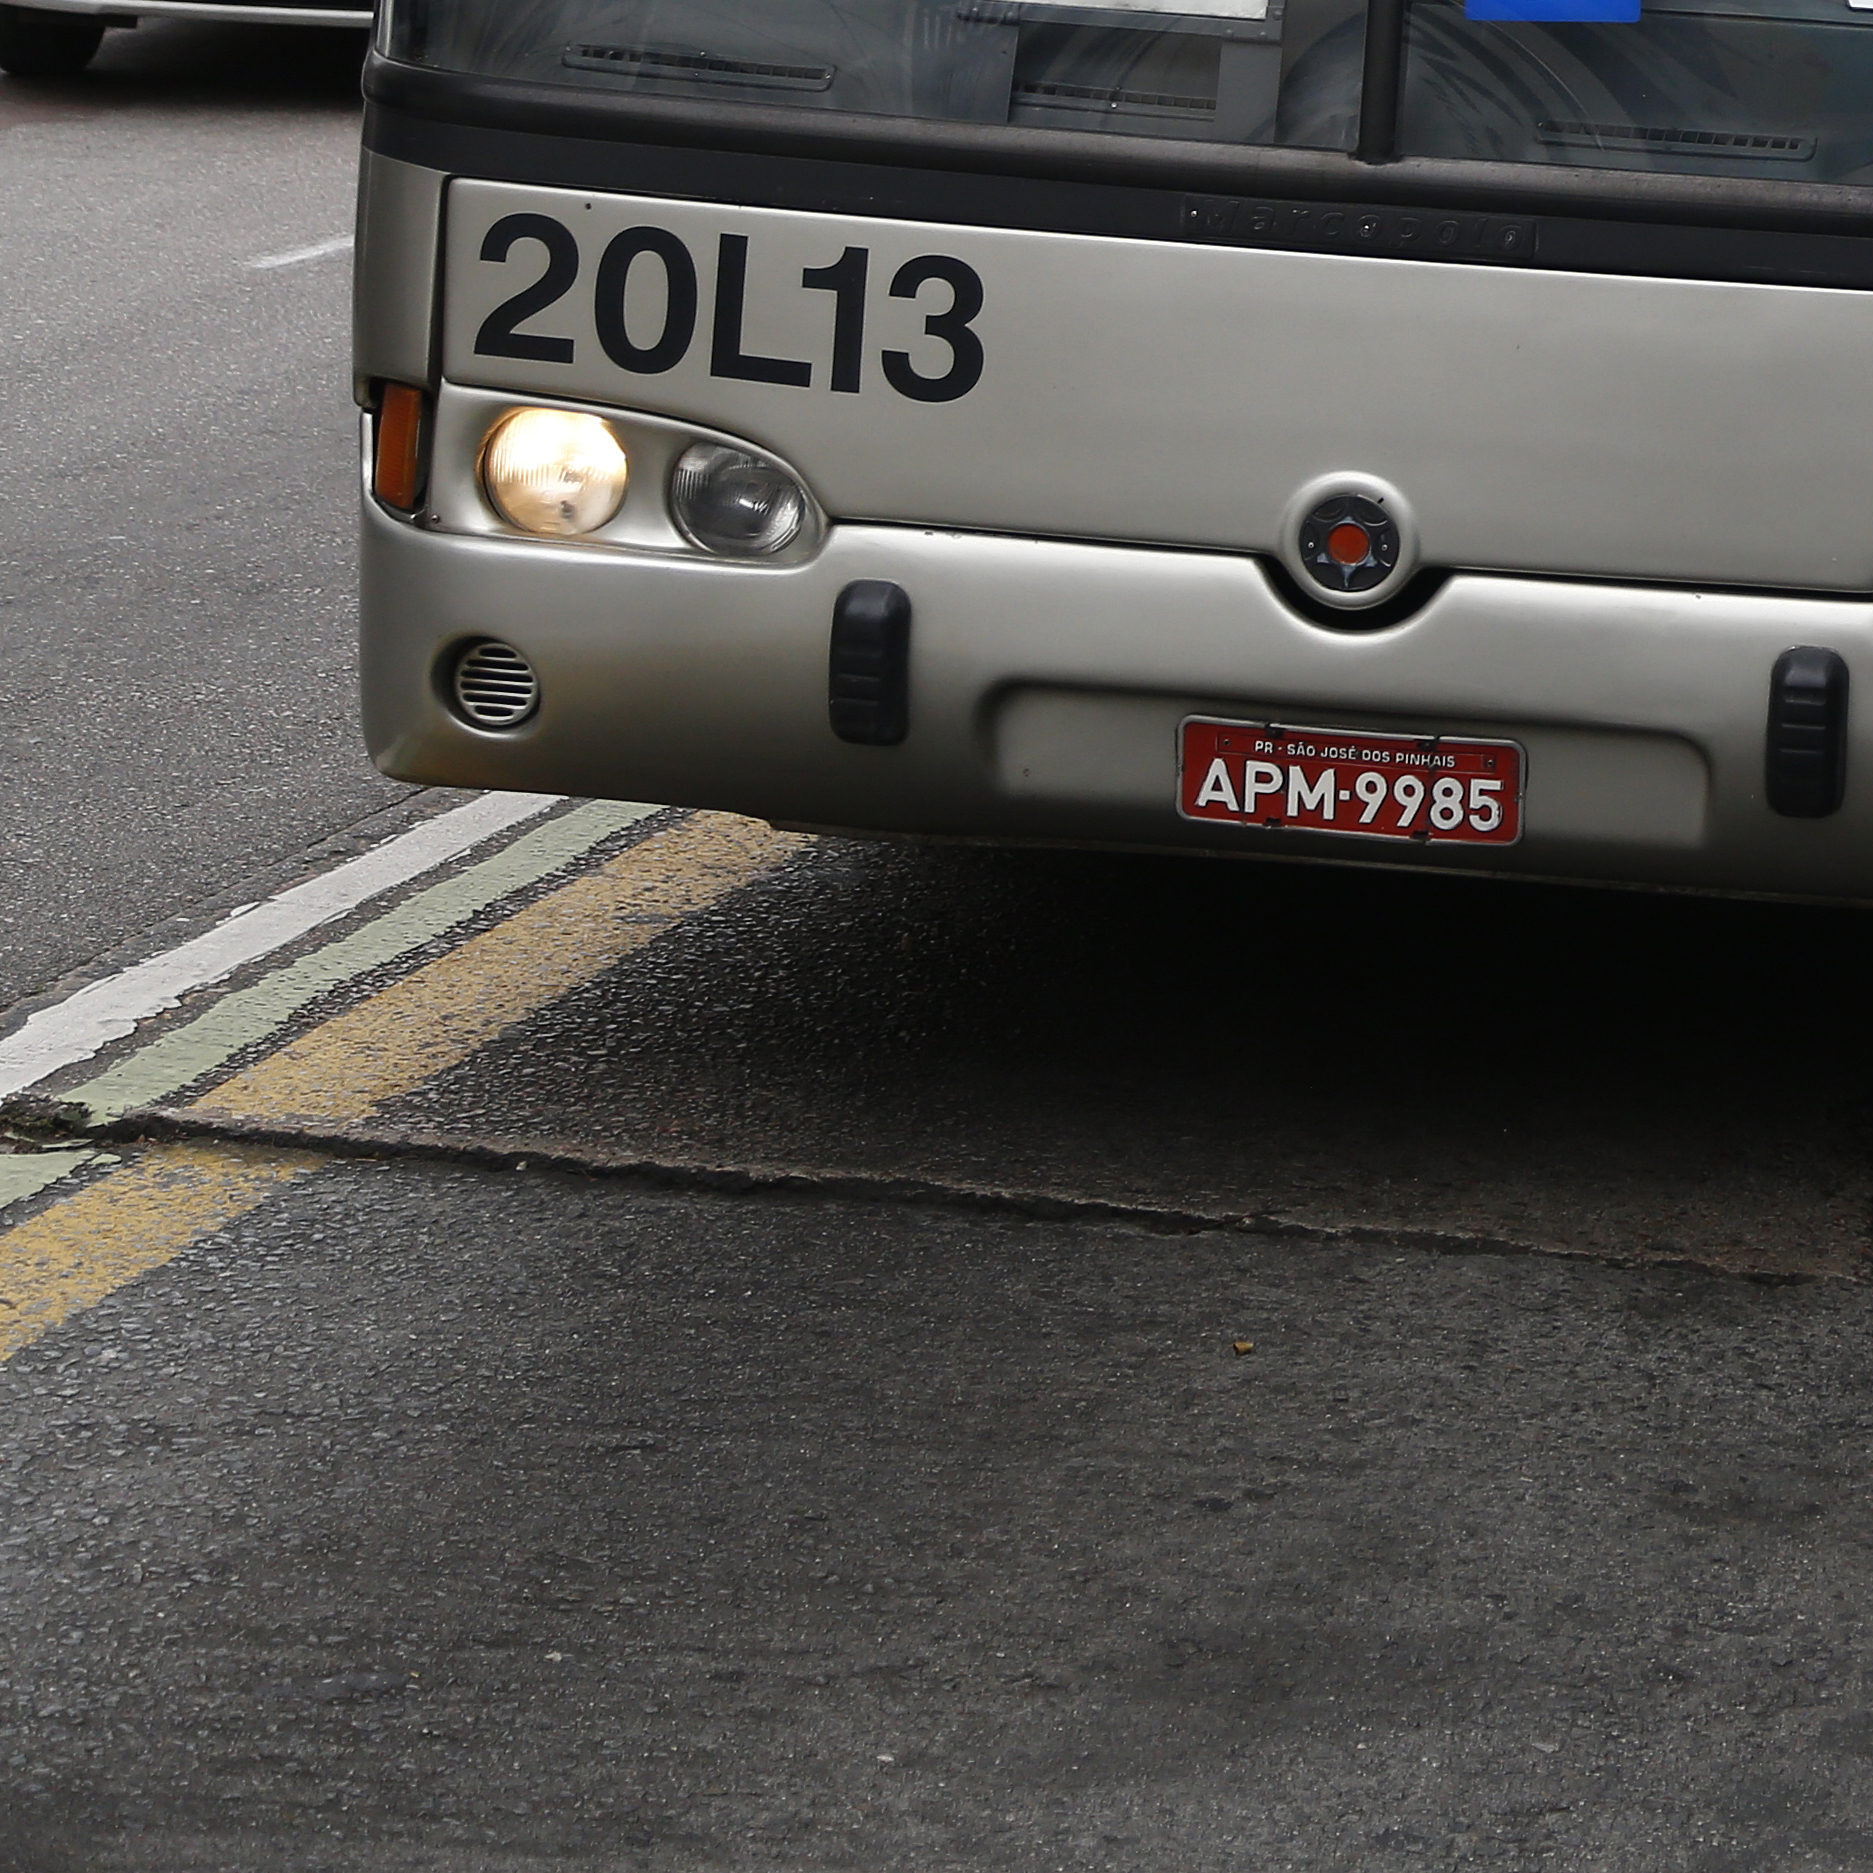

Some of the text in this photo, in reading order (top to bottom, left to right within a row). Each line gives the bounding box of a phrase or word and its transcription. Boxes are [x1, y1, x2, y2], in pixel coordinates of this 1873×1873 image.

[473, 213, 985, 403] 20L13
[1254, 740, 1274, 754] PR
[1286, 741, 1316, 757] SÃO
[1320, 745, 1357, 760] JOSÉ
[1361, 749, 1391, 763] DOS
[1395, 752, 1456, 768] PINHAIS
